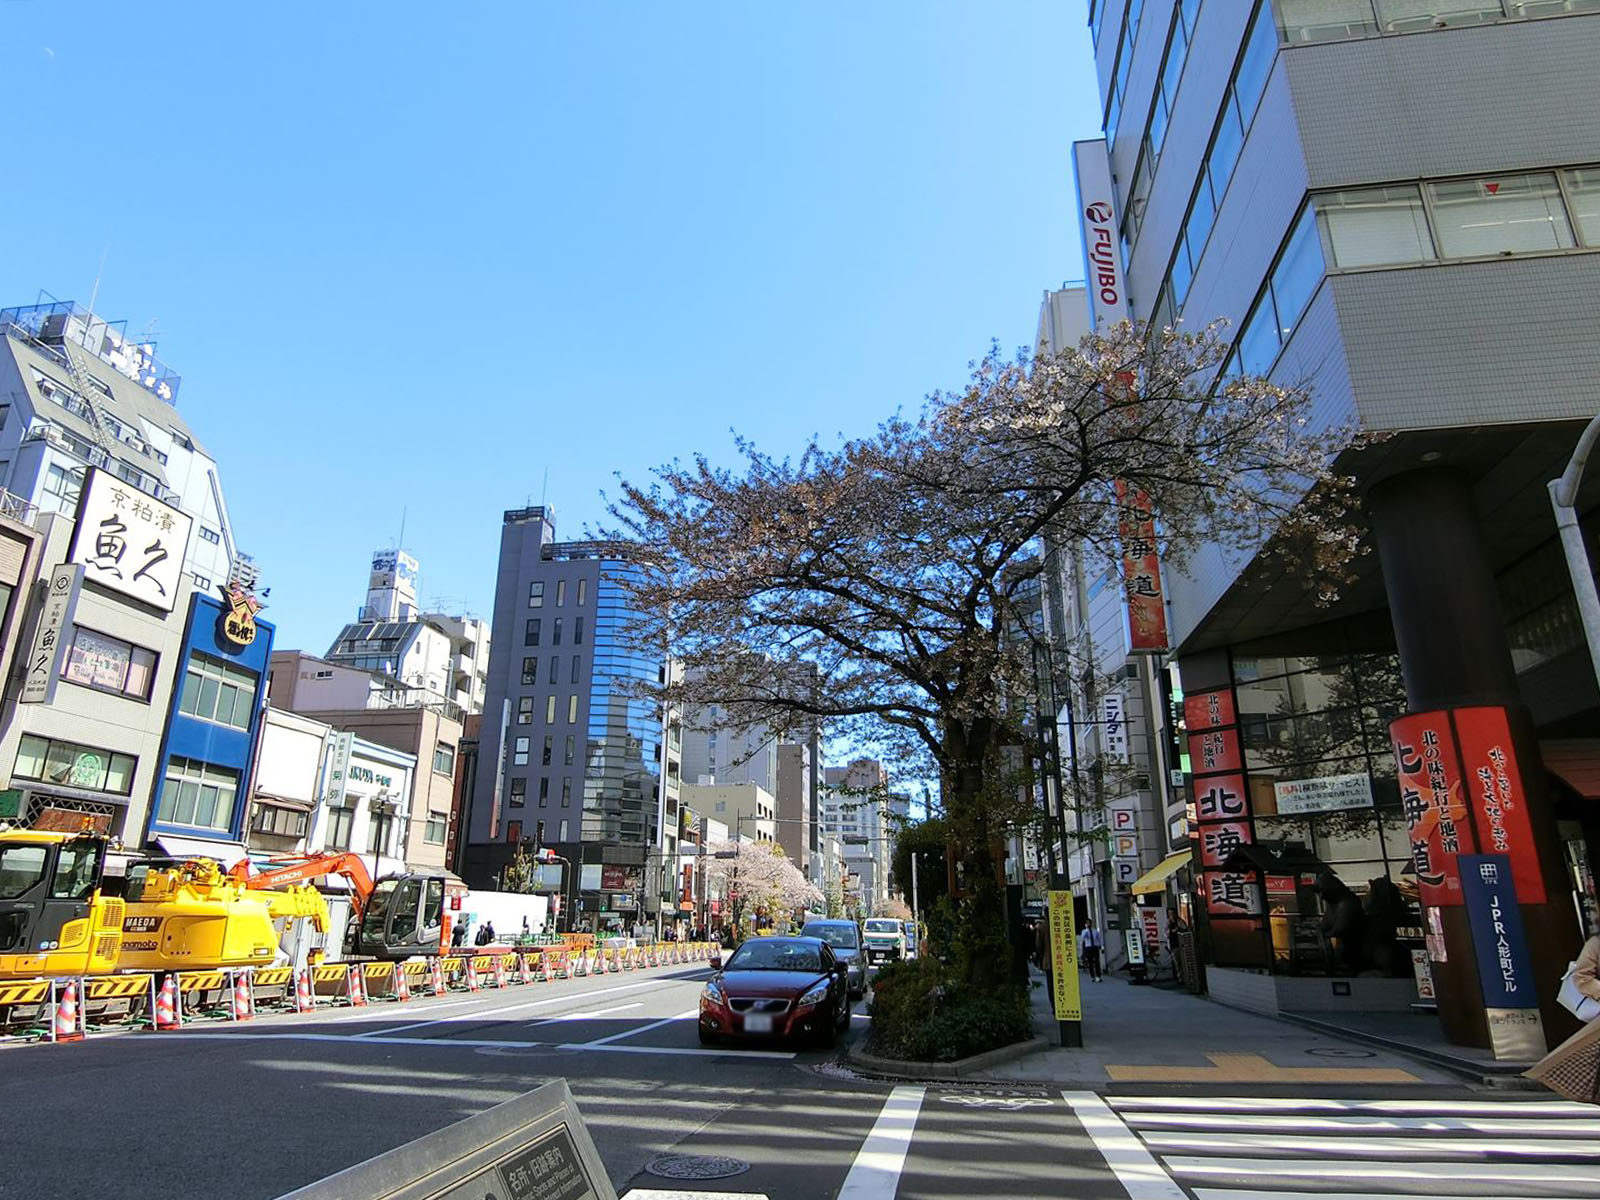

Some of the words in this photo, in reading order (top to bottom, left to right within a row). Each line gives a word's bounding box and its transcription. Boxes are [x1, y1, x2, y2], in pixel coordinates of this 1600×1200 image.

[1090, 227, 1118, 306] FUJIBO
[110, 487, 175, 534] 京粕漬
[85, 513, 168, 597] 魚久
[32, 628, 56, 675] 魚久
[1105, 699, 1122, 735] ニシダ
[1208, 694, 1221, 726] 北の味
[1203, 735, 1216, 768] と地酒
[1213, 732, 1224, 754] 紀行
[1423, 730, 1460, 853] 北の味紀行と地酒
[1117, 813, 1131, 828] P
[1119, 838, 1133, 854] P
[1200, 787, 1249, 909] 北海道
[271, 870, 304, 883] HITACHI
[1120, 864, 1132, 879] P
[126, 917, 156, 927] MAEDA
[1143, 910, 1160, 957] KIRIN
[1490, 896, 1517, 992] JPR人形町ビル
[509, 1145, 565, 1193] 名所・旧跡案内
